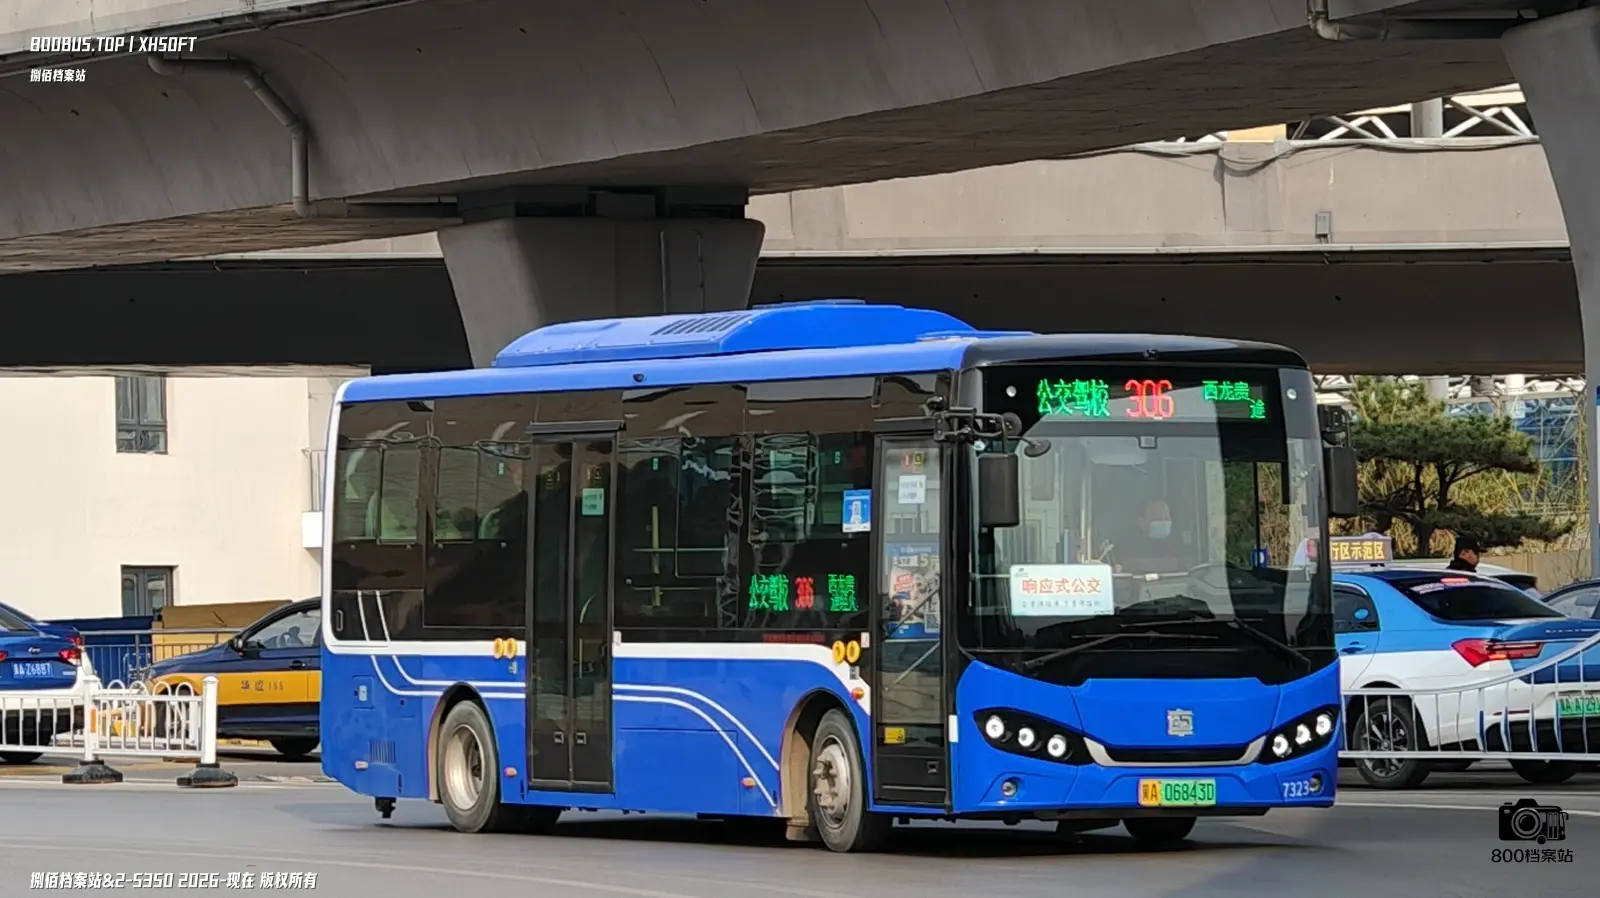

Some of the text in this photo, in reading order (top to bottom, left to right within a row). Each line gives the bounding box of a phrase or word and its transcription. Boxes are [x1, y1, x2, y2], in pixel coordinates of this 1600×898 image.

[1036, 378, 1111, 417] 公交驾校
[1124, 379, 1174, 419] 306
[1021, 577, 1102, 594] 响应式公交
[1282, 780, 1310, 797] 7323
